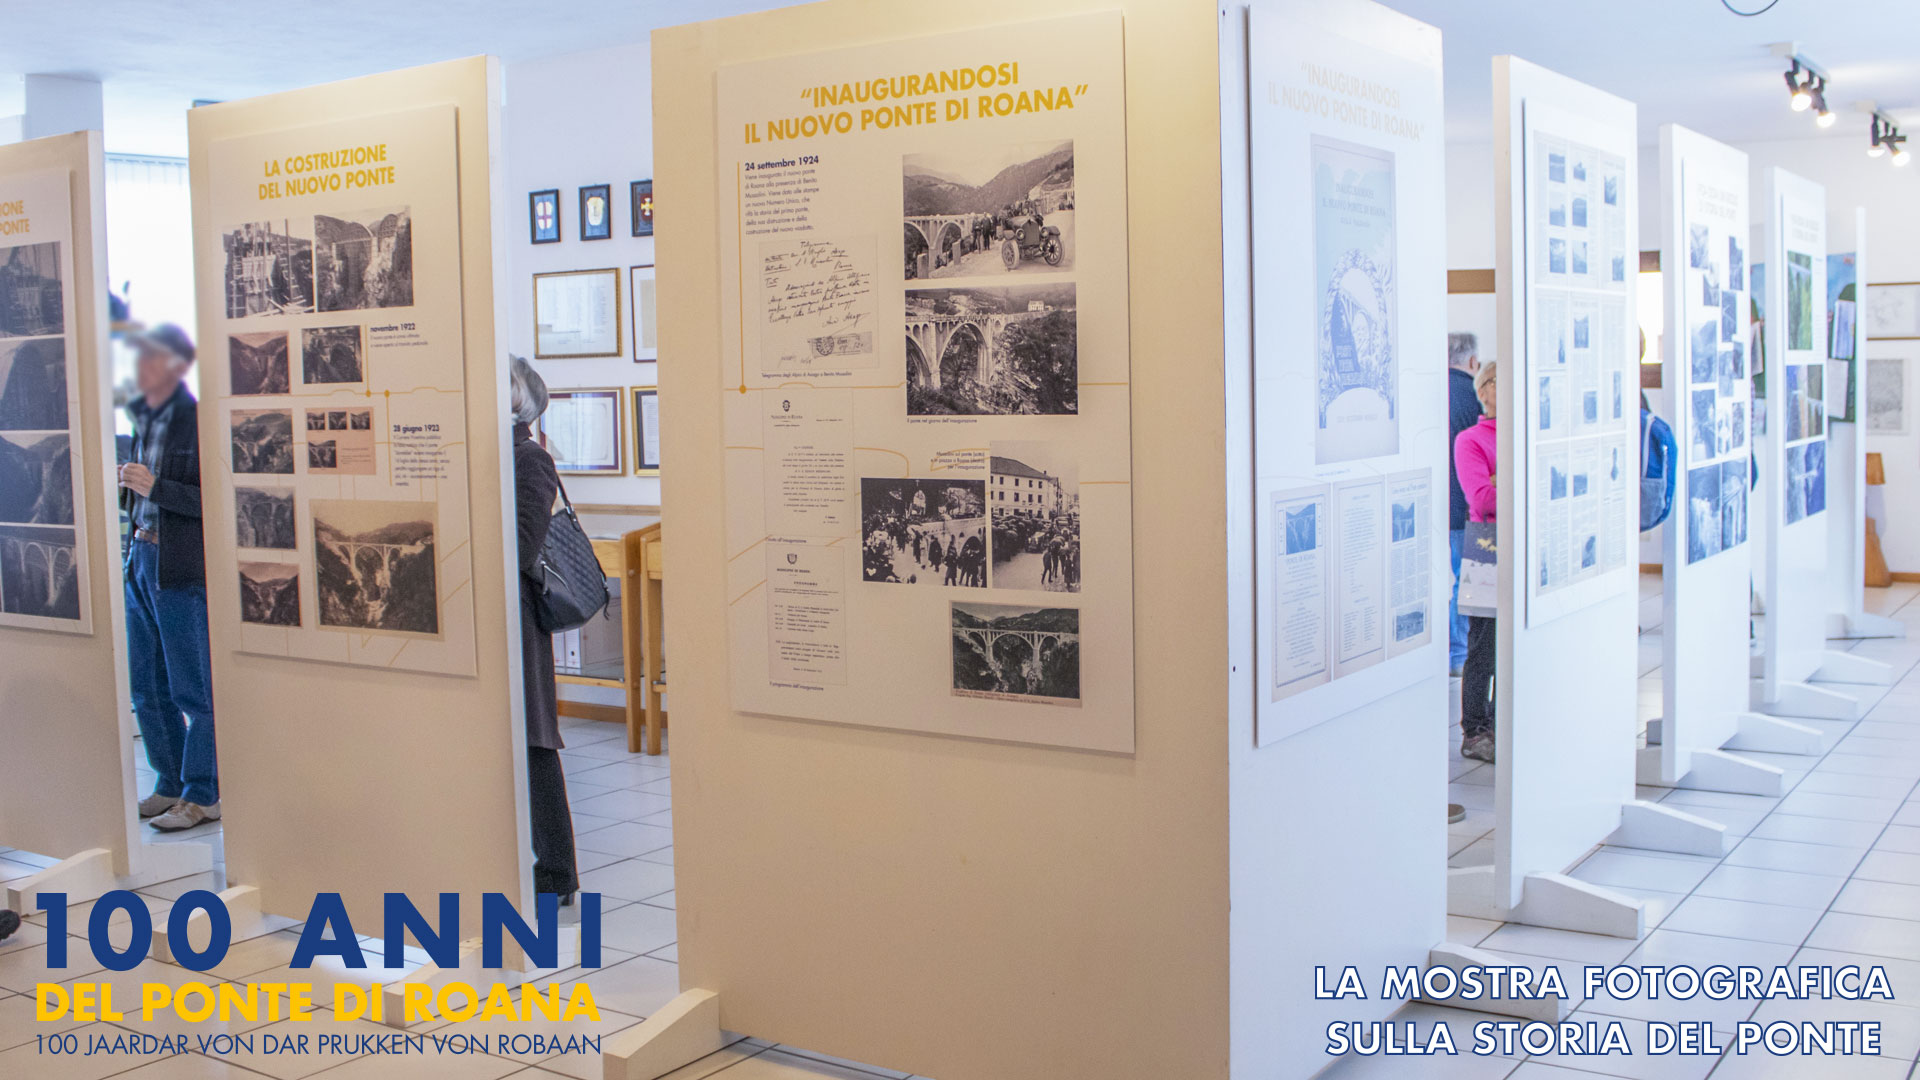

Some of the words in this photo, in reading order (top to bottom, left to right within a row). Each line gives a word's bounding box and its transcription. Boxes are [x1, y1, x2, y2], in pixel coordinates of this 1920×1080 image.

[800, 62, 1019, 107] “INAUGURANDOSI
[745, 123, 760, 144] IL
[768, 113, 852, 141] NUOVO
[861, 102, 936, 131] PONTE
[946, 99, 968, 122] DI
[978, 85, 1088, 118] ROANA”
[1268, 80, 1278, 104] IL
[1282, 86, 1328, 117] NUOVO
[1333, 99, 1368, 127] PONTE
[1371, 110, 1381, 131] DI
[265, 160, 280, 177] LA
[285, 144, 386, 174] COSTRUZIONE
[745, 163, 754, 171] 24
[758, 159, 795, 170] settembre
[799, 155, 819, 165] 1924
[259, 182, 281, 200] DEL
[286, 174, 340, 197] NUOVO
[346, 166, 395, 189] PONTE
[400, 322, 416, 331] 1922
